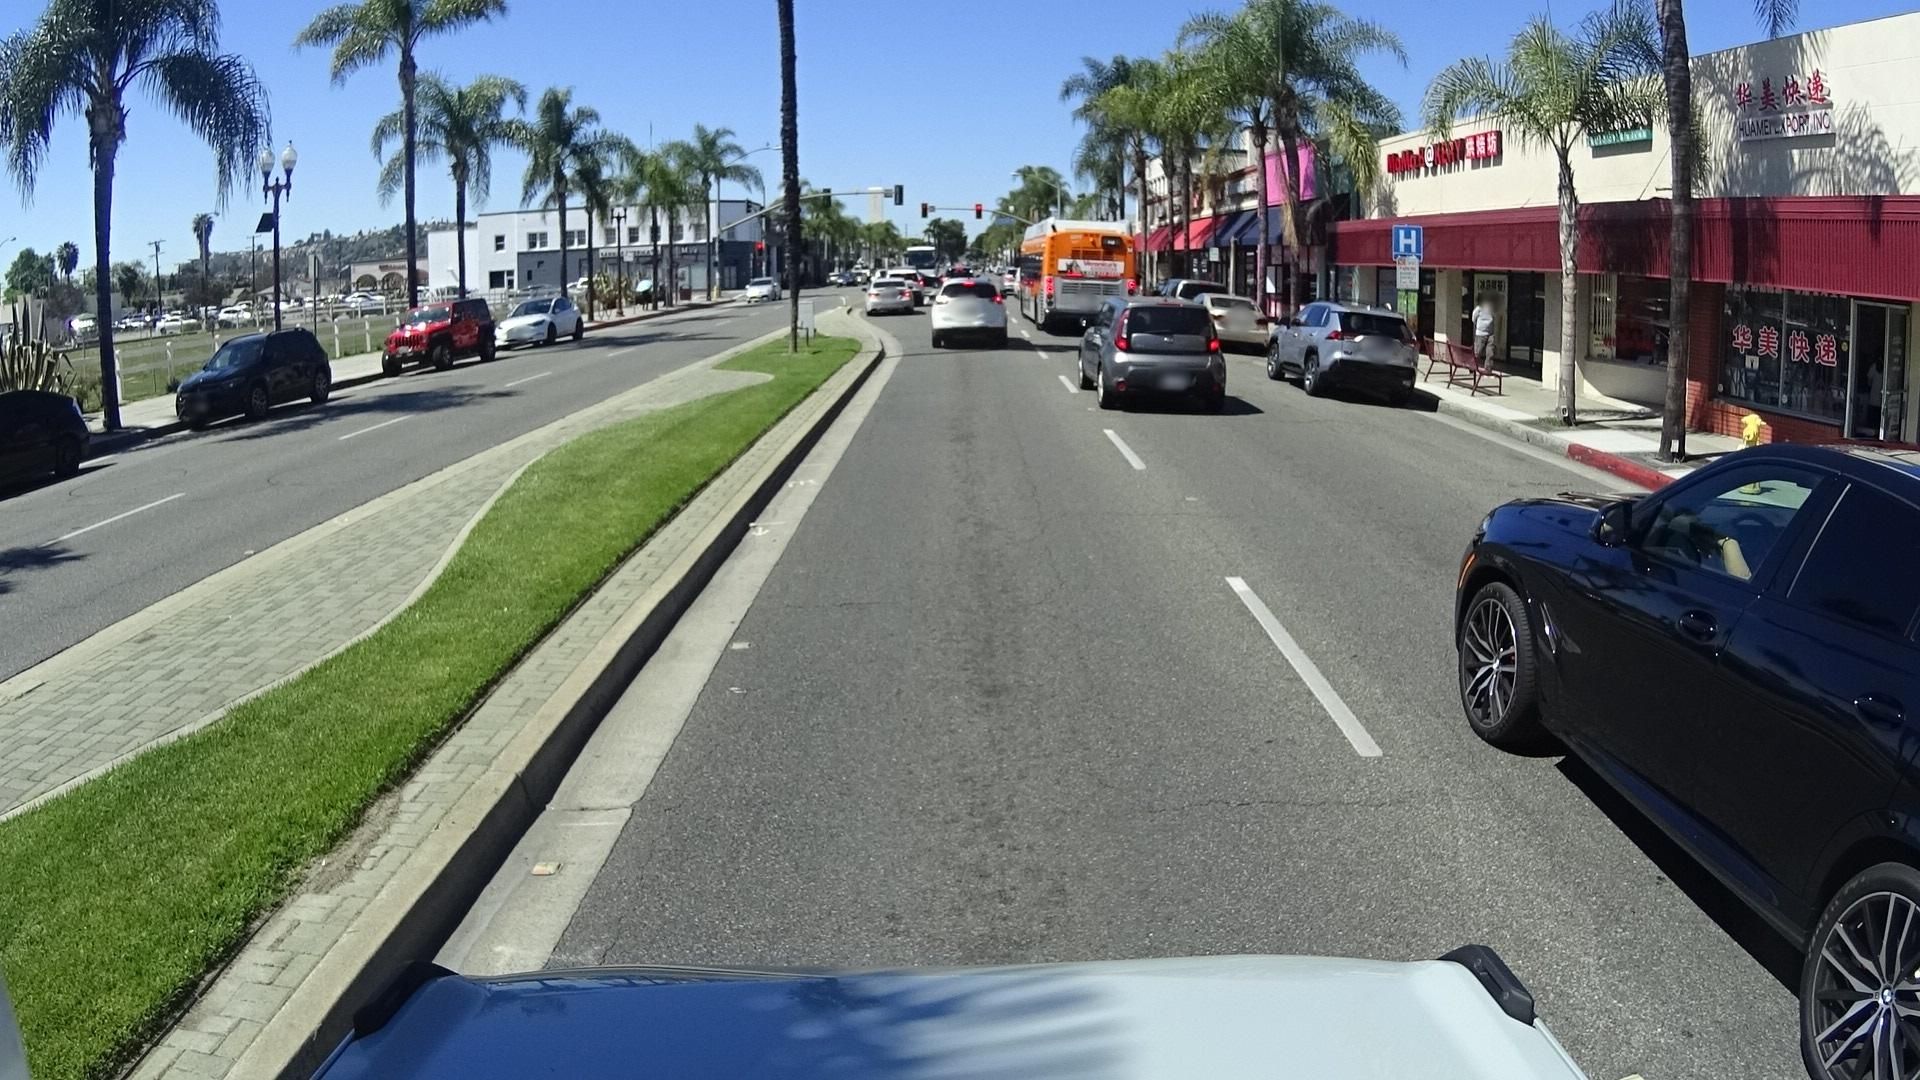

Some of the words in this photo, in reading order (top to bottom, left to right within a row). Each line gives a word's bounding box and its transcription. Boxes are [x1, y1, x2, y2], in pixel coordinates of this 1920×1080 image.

[1736, 68, 1827, 112] 华美快递
[1813, 113, 1831, 130] INC
[1399, 229, 1417, 253] H
[1732, 324, 1838, 367] 华美快递
